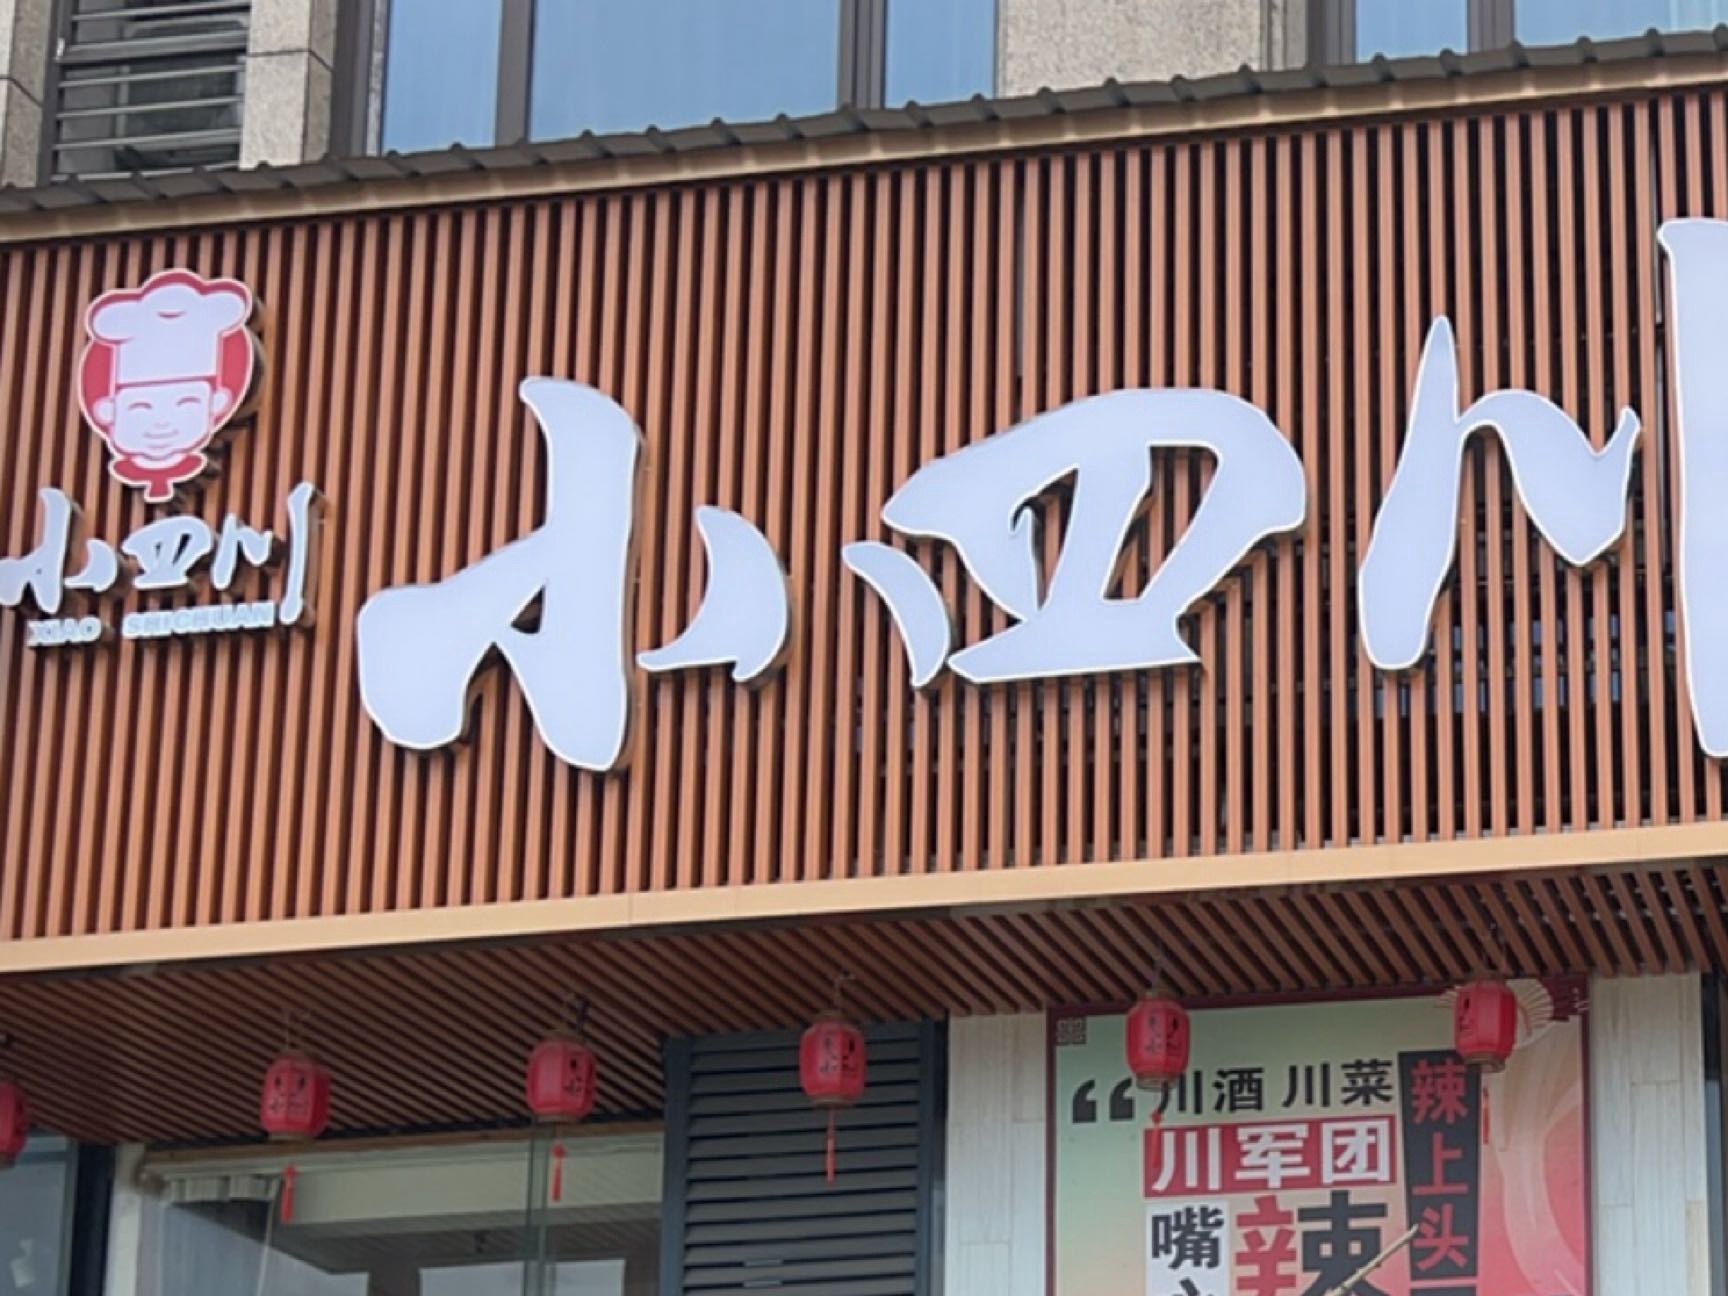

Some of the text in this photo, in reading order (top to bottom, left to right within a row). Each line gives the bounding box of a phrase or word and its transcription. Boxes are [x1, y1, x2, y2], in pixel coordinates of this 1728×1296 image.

[27, 601, 275, 647] XIAO SHICHUAN
[1151, 1119, 1390, 1192] 川军团
[1411, 1058, 1469, 1272] 辣上头
